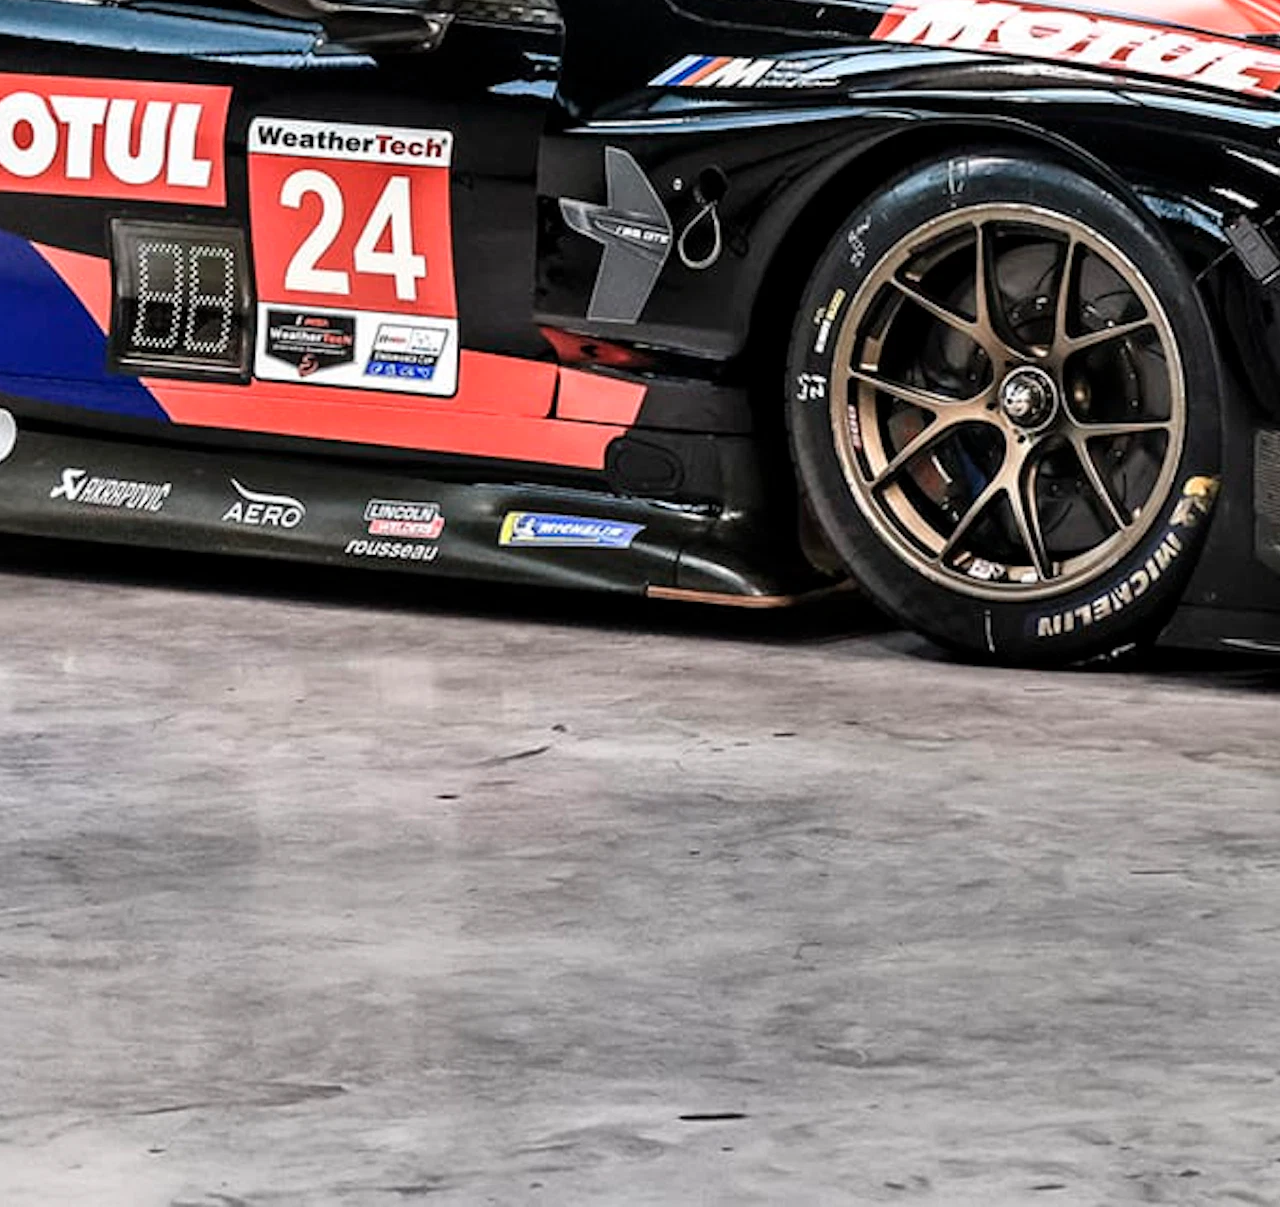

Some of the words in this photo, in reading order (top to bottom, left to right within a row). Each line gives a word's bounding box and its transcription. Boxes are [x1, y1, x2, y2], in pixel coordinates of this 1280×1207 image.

[258, 125, 444, 158] WeatherTech
[279, 168, 427, 301] 24
[222, 502, 303, 528] AERO
[369, 504, 435, 522] LINCOLN
[344, 539, 439, 561] rousseau
[1037, 531, 1182, 637] MICHELIN
